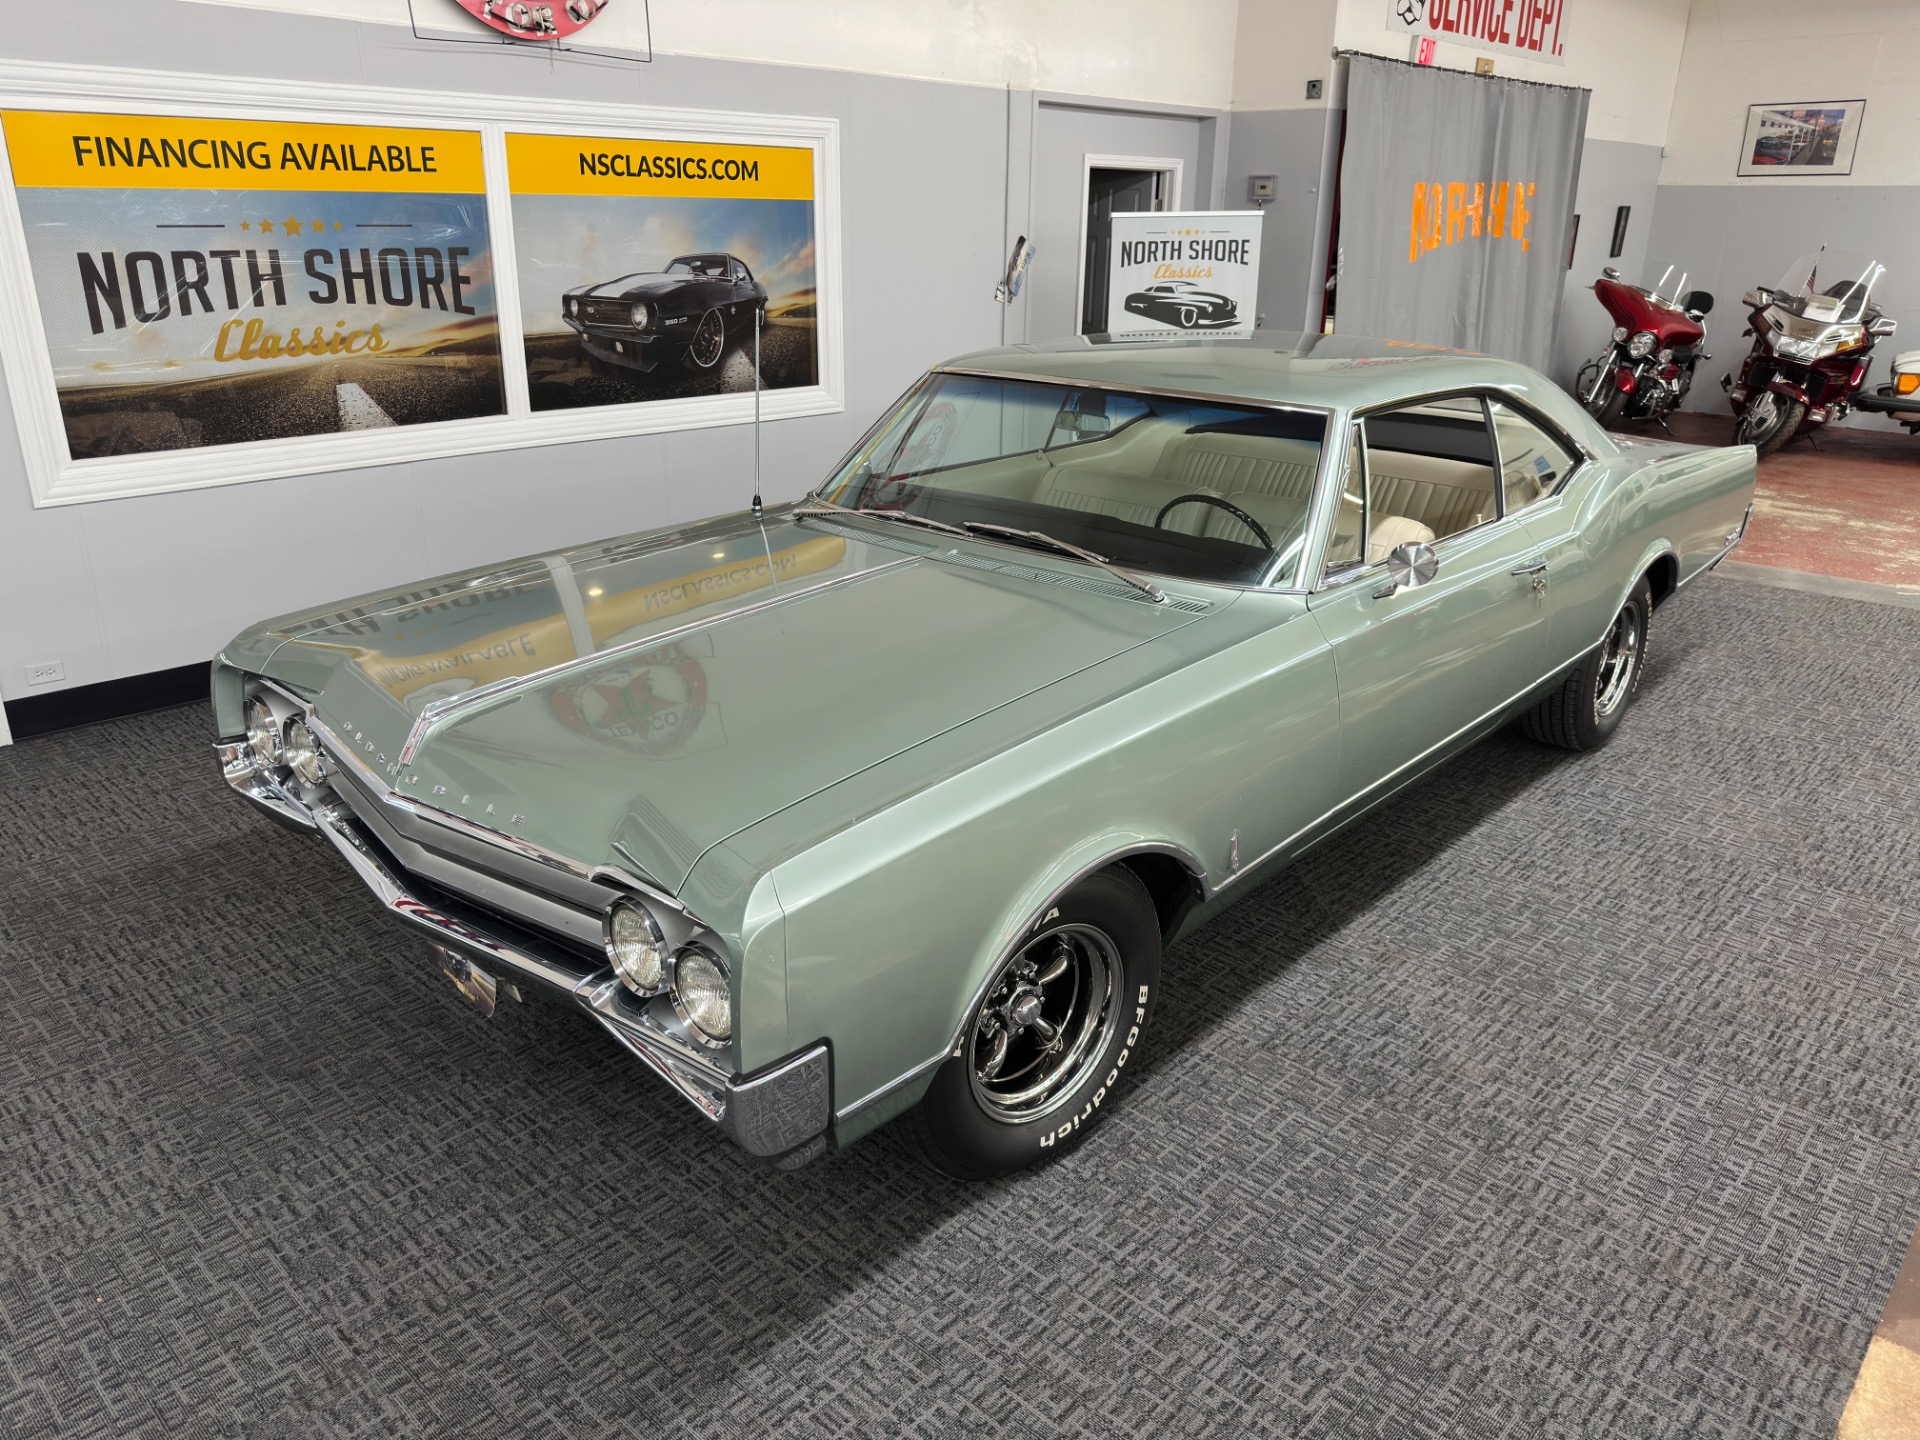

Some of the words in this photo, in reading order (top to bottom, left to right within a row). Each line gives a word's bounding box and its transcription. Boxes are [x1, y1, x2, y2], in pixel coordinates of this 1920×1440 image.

[72, 135, 271, 171] FINANCING
[280, 143, 437, 173] AVAILABLE
[579, 152, 760, 182] NSCLASSICS.COM
[1120, 240, 1182, 268] NORTH
[1188, 239, 1250, 266] SHORE
[1153, 263, 1214, 279] Classics
[77, 250, 288, 335] NORTH
[304, 247, 476, 316] SHORE
[213, 317, 390, 363] Classics
[1040, 985, 1149, 1148] BFGoodrich
